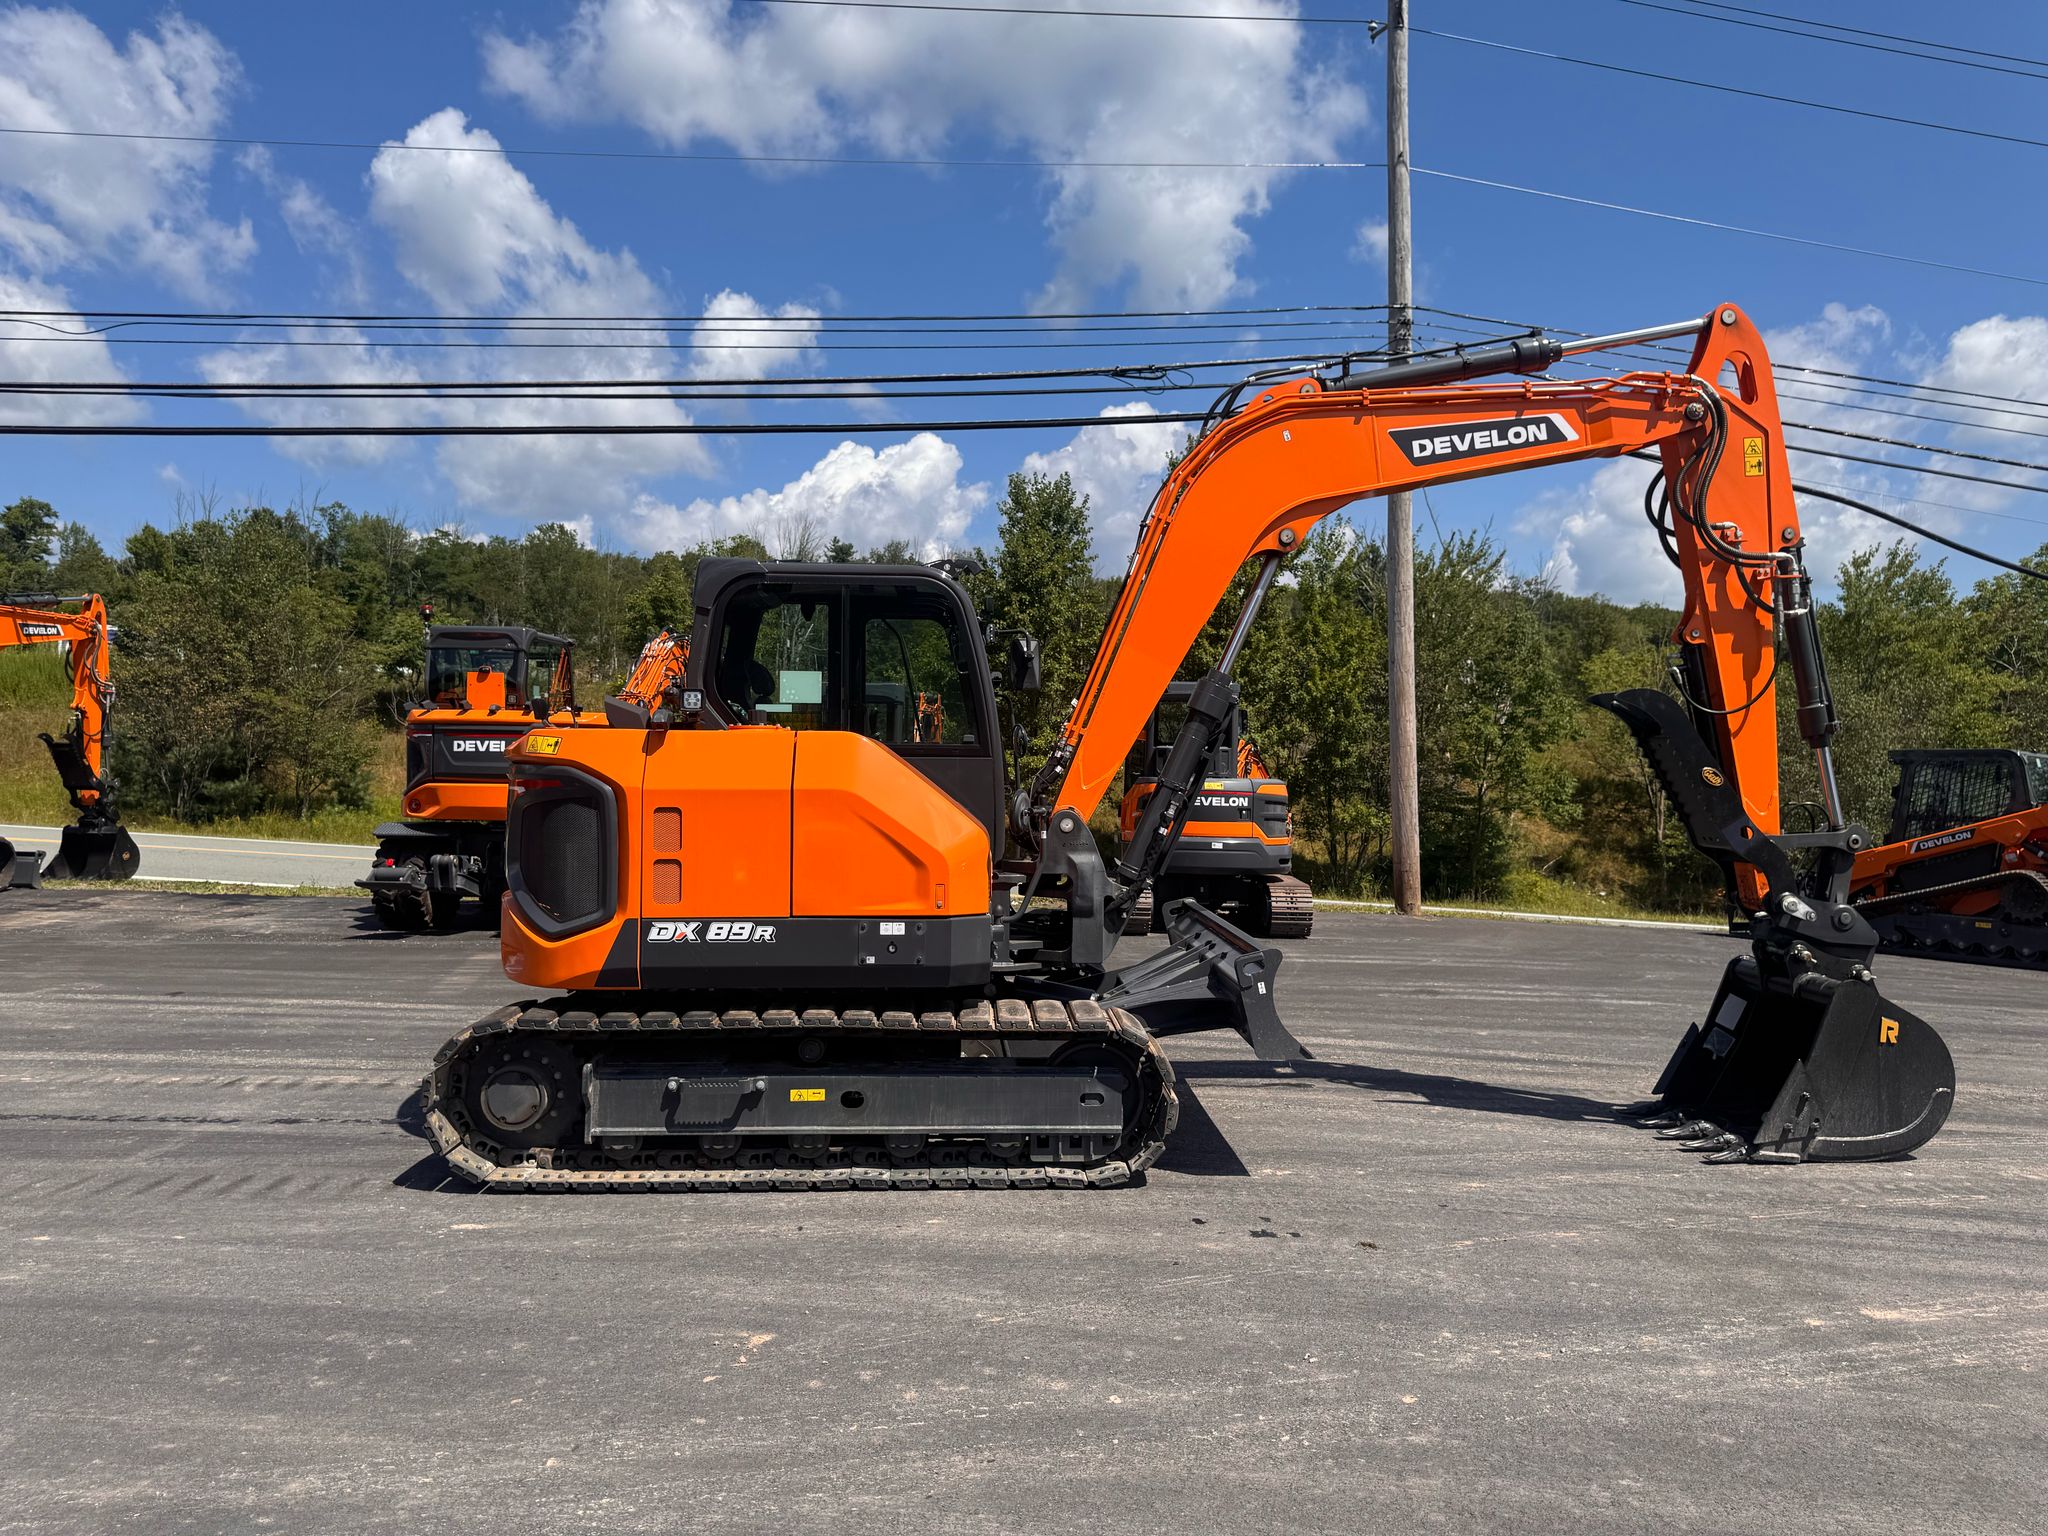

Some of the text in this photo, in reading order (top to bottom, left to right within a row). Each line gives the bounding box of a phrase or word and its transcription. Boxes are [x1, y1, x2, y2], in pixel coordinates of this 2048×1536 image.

[1412, 423, 1548, 458] DEVELON
[23, 626, 58, 635] DEVELON
[1919, 831, 1972, 850] DEVELON
[647, 922, 702, 942] DX
[1879, 1016, 1900, 1044] R
